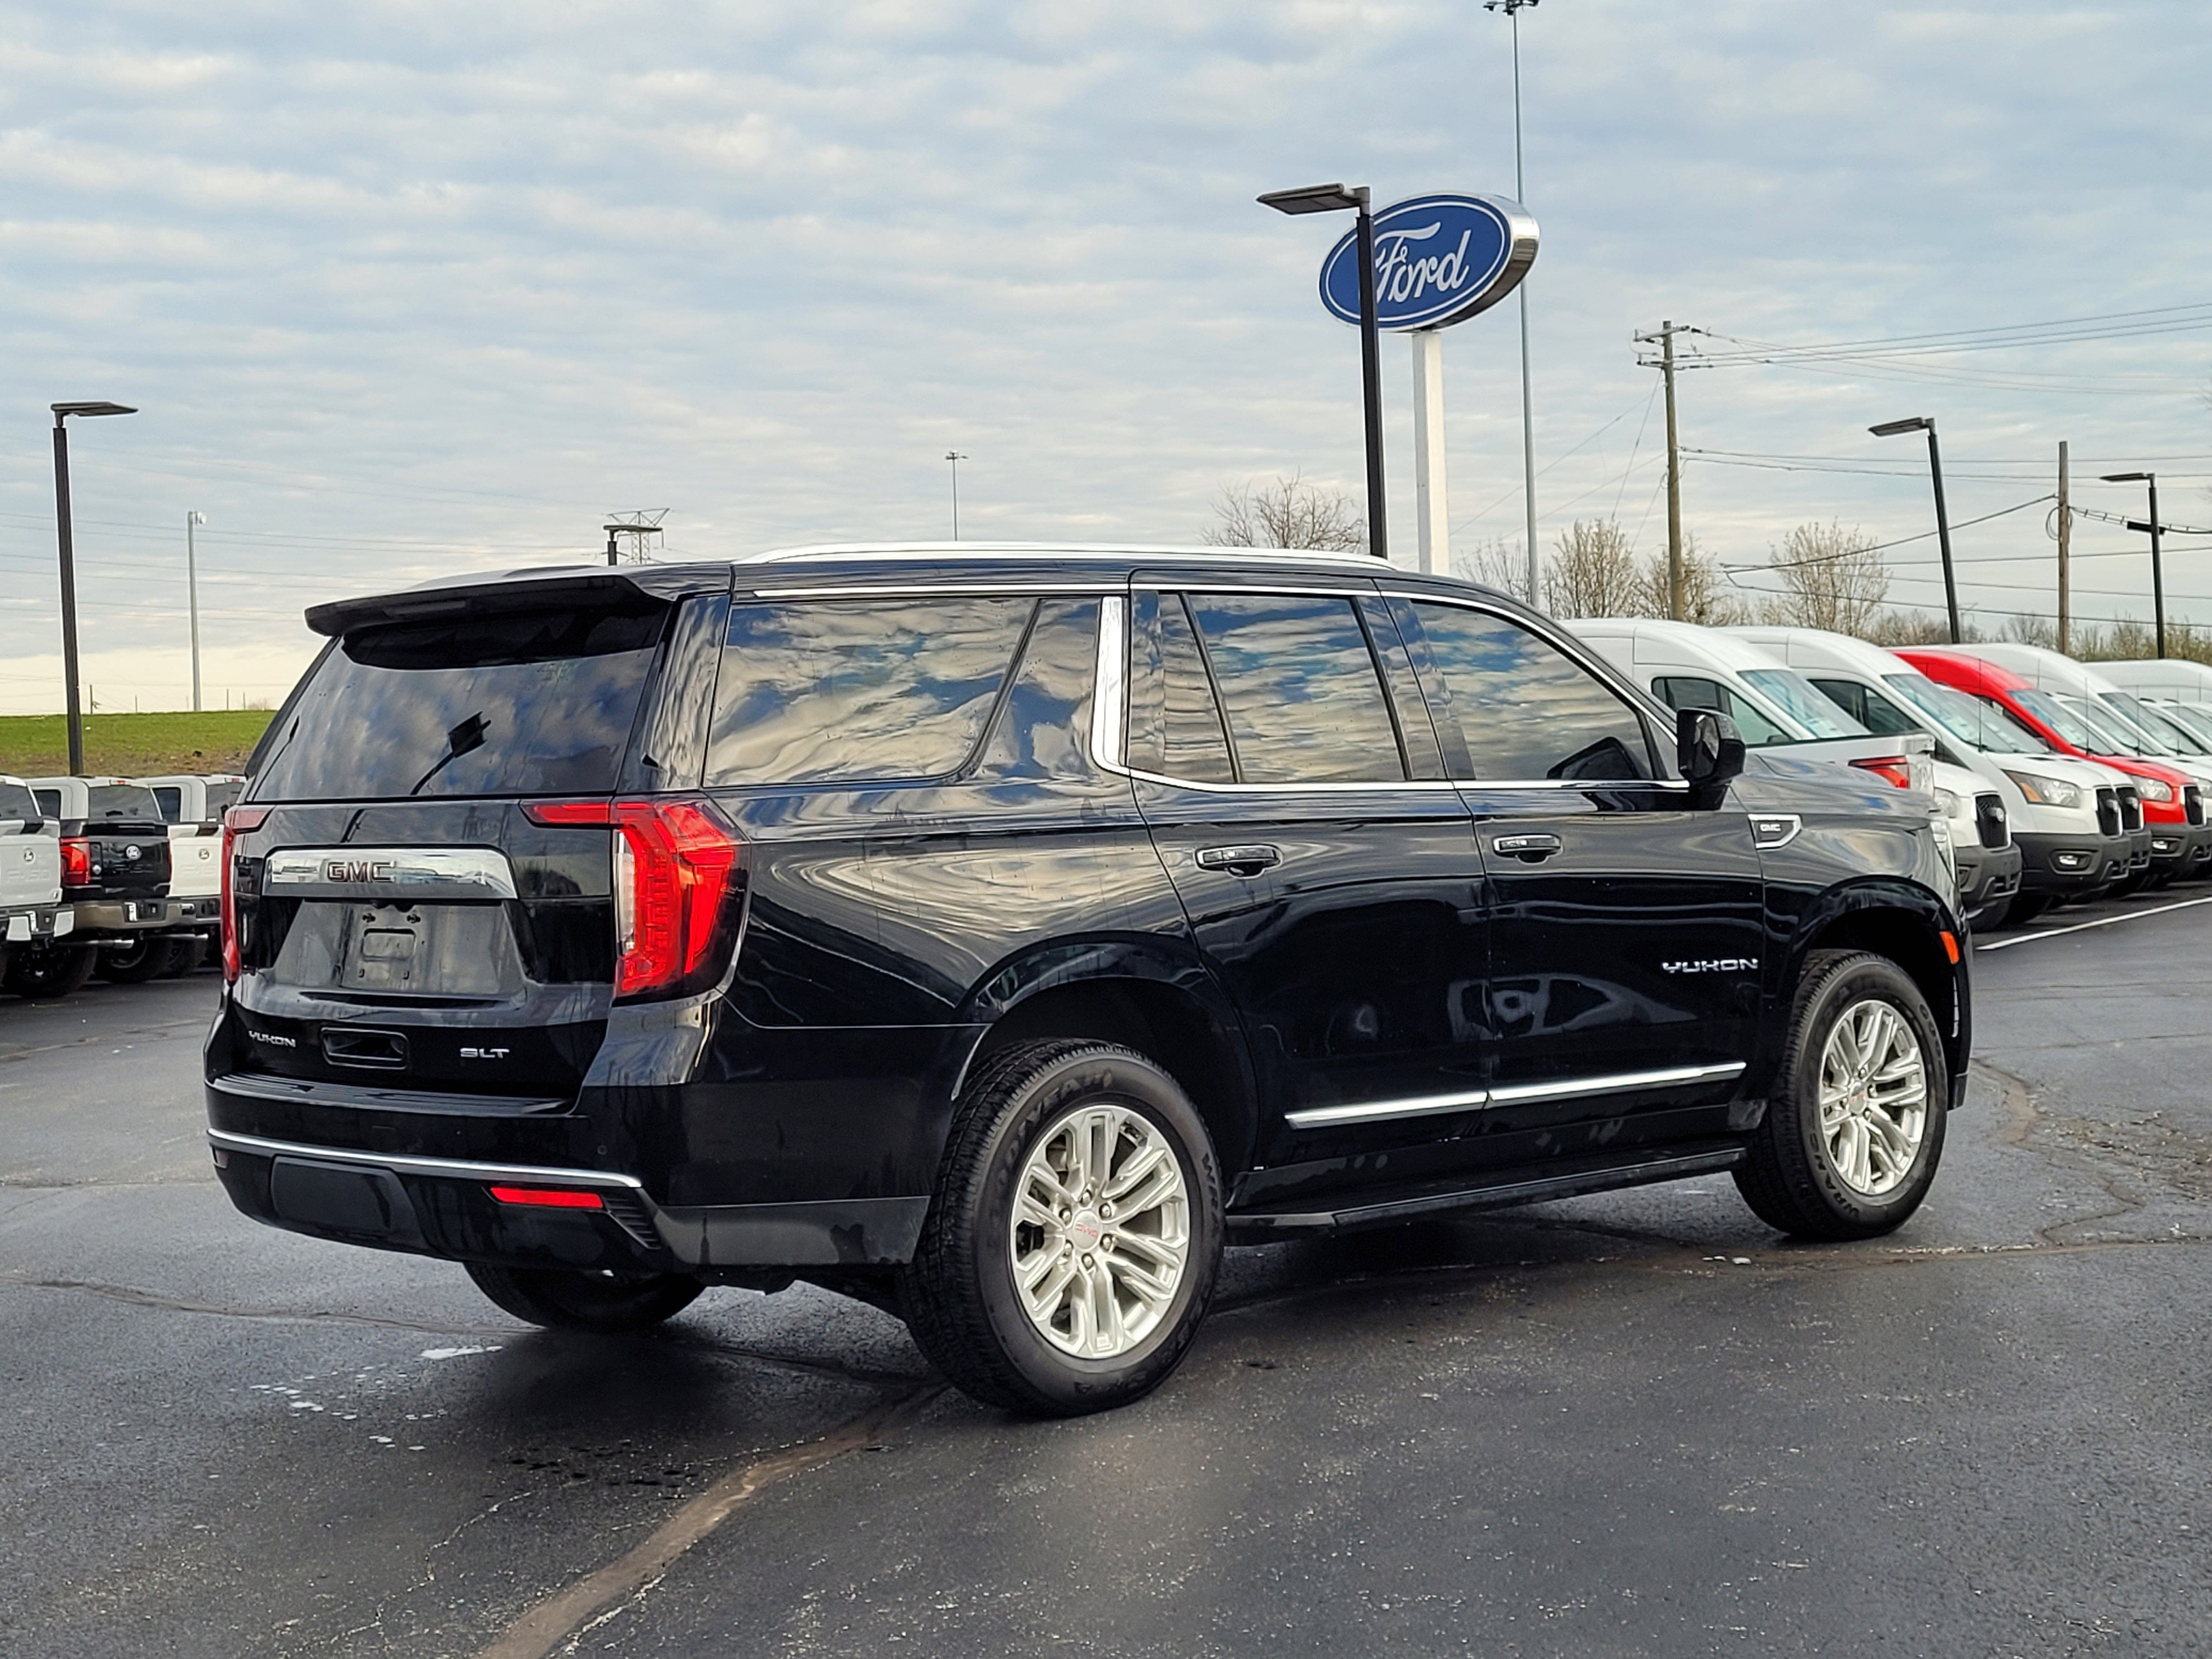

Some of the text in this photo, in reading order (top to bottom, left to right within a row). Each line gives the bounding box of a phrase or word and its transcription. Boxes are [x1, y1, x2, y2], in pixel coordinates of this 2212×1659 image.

[1374, 222, 1471, 303] Ford
[328, 861, 396, 883] GMC
[1662, 958, 1758, 973] YUKON
[249, 1030, 296, 1047] YUKON
[460, 1048, 510, 1058] SLT
